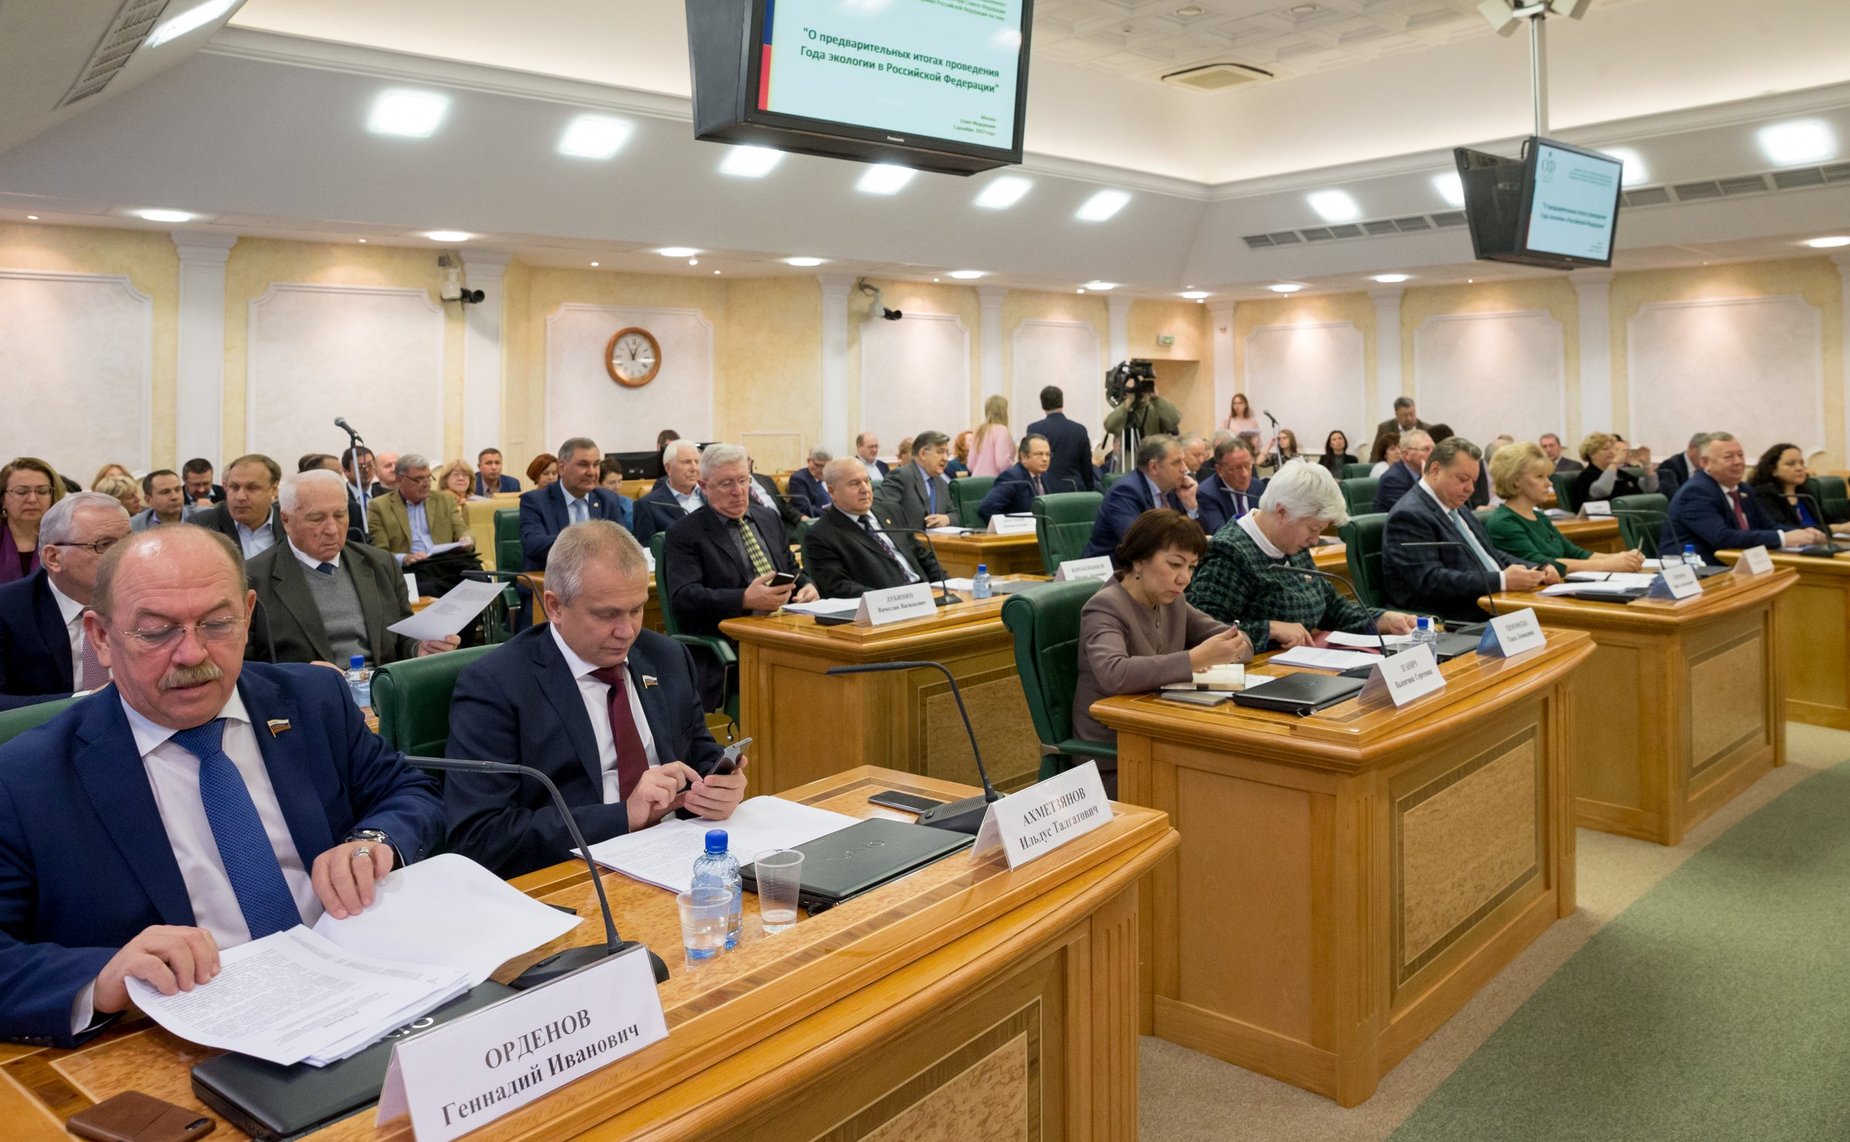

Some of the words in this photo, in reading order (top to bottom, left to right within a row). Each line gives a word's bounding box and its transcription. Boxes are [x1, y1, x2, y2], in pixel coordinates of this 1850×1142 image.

[800, 45, 826, 61] Года
[828, 53, 876, 71] экологии
[877, 63, 884, 71] в
[886, 62, 942, 82] Российской
[943, 74, 1000, 93] Федерации"
[803, 27, 817, 40] "О
[819, 33, 911, 60] предварительных
[913, 52, 943, 66] итогах
[945, 60, 1000, 78] проведения
[1019, 828, 1053, 851] Ильдус
[1052, 805, 1099, 834] Талгатович
[1022, 787, 1086, 827] АХМЕТЗЯНОВ
[485, 1008, 592, 1070] ОРДЕНОВ
[441, 1064, 544, 1127] Геннадий
[547, 1023, 640, 1078] Иванович
